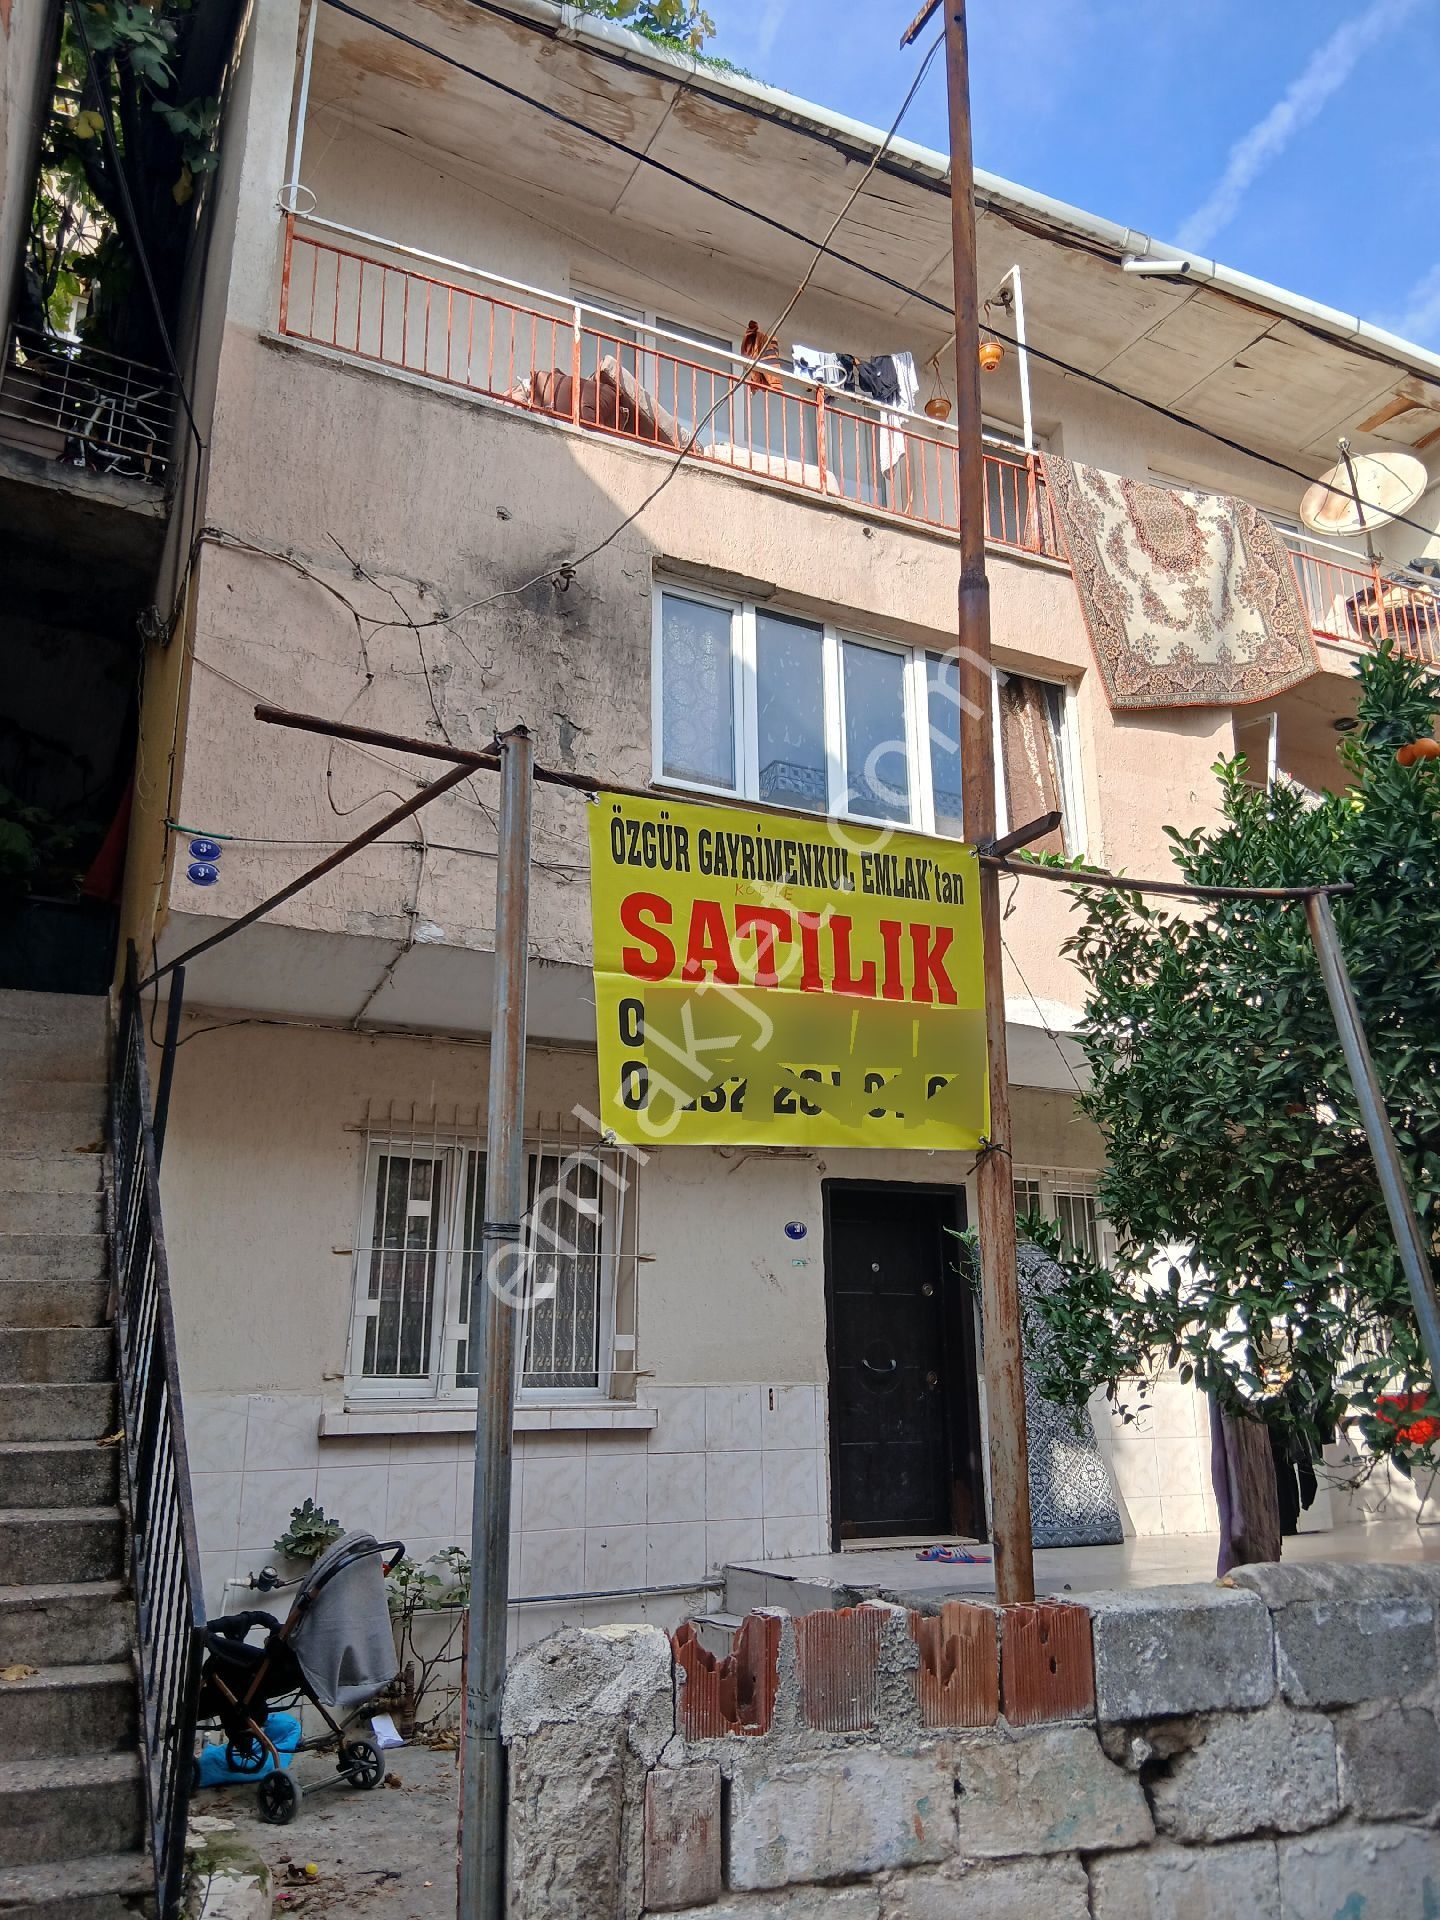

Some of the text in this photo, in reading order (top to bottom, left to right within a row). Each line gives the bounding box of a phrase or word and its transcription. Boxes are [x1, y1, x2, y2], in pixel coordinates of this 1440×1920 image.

[611, 804, 964, 905] ÖZGÜR GAYRİMENKUL EMLAK'tan
[620, 891, 958, 1006] SATILIK
